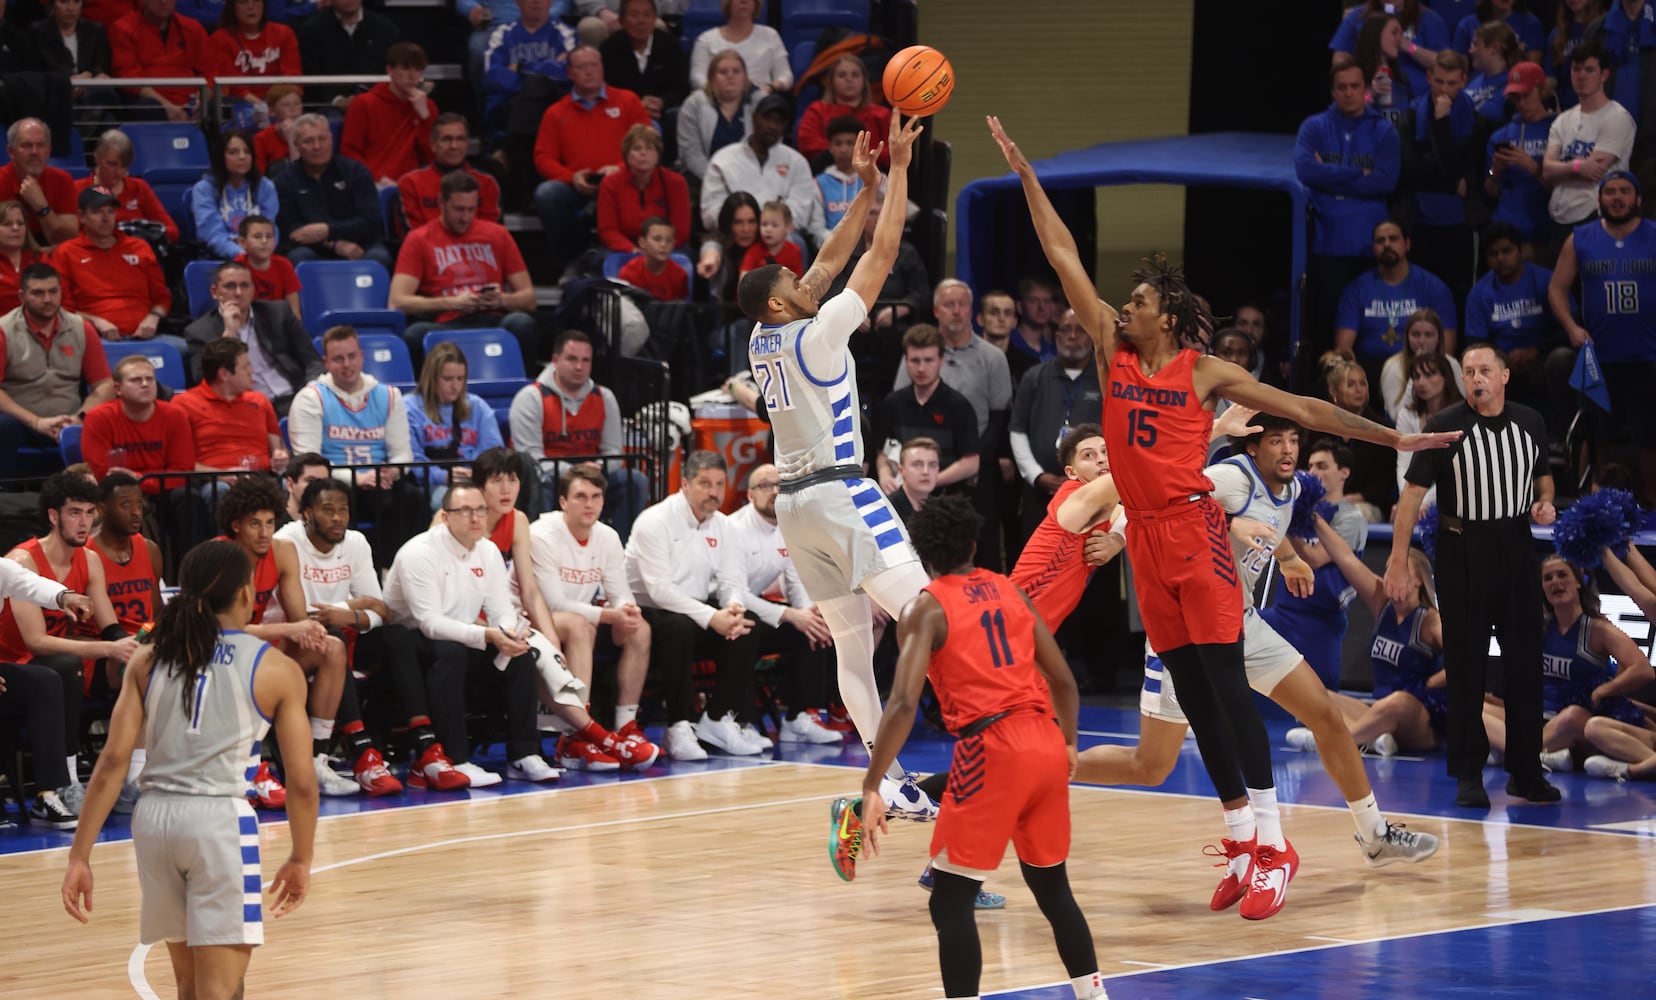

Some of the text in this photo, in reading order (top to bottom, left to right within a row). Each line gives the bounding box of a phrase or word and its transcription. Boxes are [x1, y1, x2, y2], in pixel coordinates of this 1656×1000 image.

[433, 243, 497, 275] DAYTON
[1604, 281, 1640, 314] 18
[750, 333, 782, 353] PARKER
[755, 358, 798, 411] 21
[1111, 380, 1188, 408] DAYTON
[328, 424, 387, 441] DAYTON
[1127, 407, 1159, 448] 15
[344, 445, 373, 466] 15
[732, 436, 757, 464] G
[962, 581, 1001, 604] SMITH
[979, 608, 1015, 669] 11
[1372, 637, 1402, 665] SLU
[1542, 656, 1570, 679] SLU
